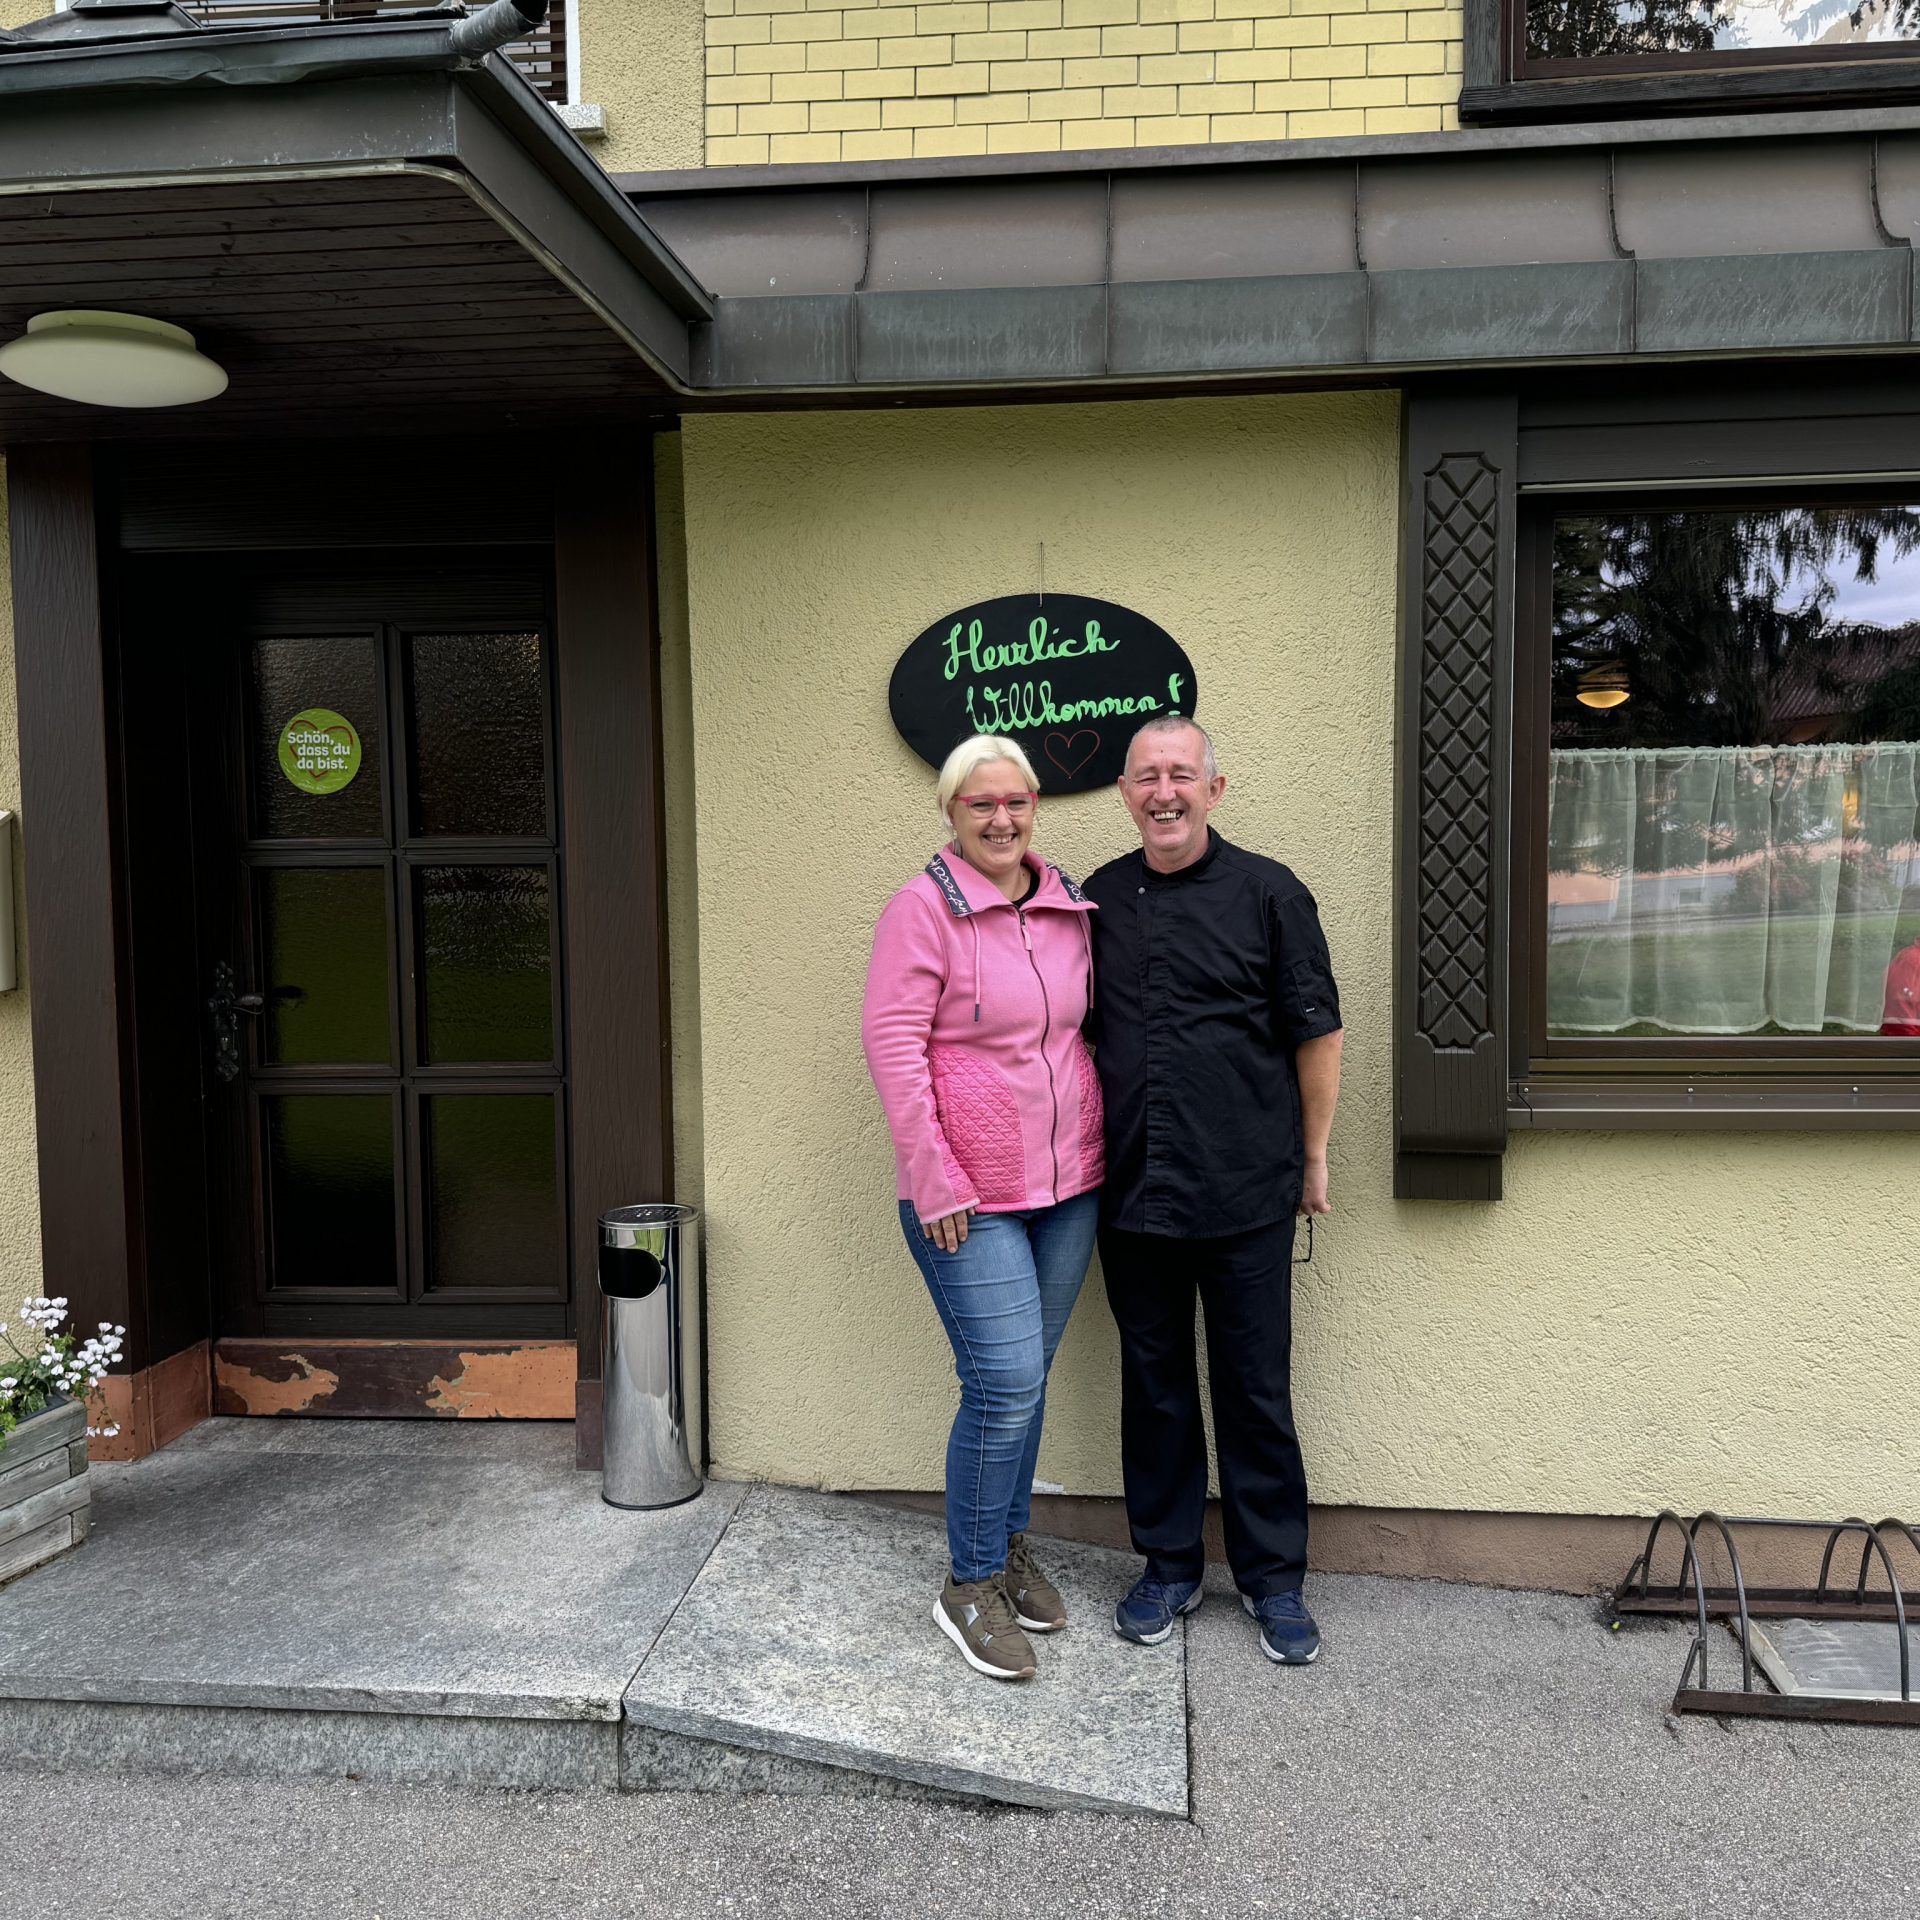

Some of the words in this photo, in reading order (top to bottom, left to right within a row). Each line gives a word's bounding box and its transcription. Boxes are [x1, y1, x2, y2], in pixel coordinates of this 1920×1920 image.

[942, 616, 1121, 680] Herzlich
[287, 730, 335, 745] Schön,
[297, 743, 329, 756] dass
[332, 743, 351, 755] du
[297, 757, 314, 769] da
[317, 757, 348, 769] bist.
